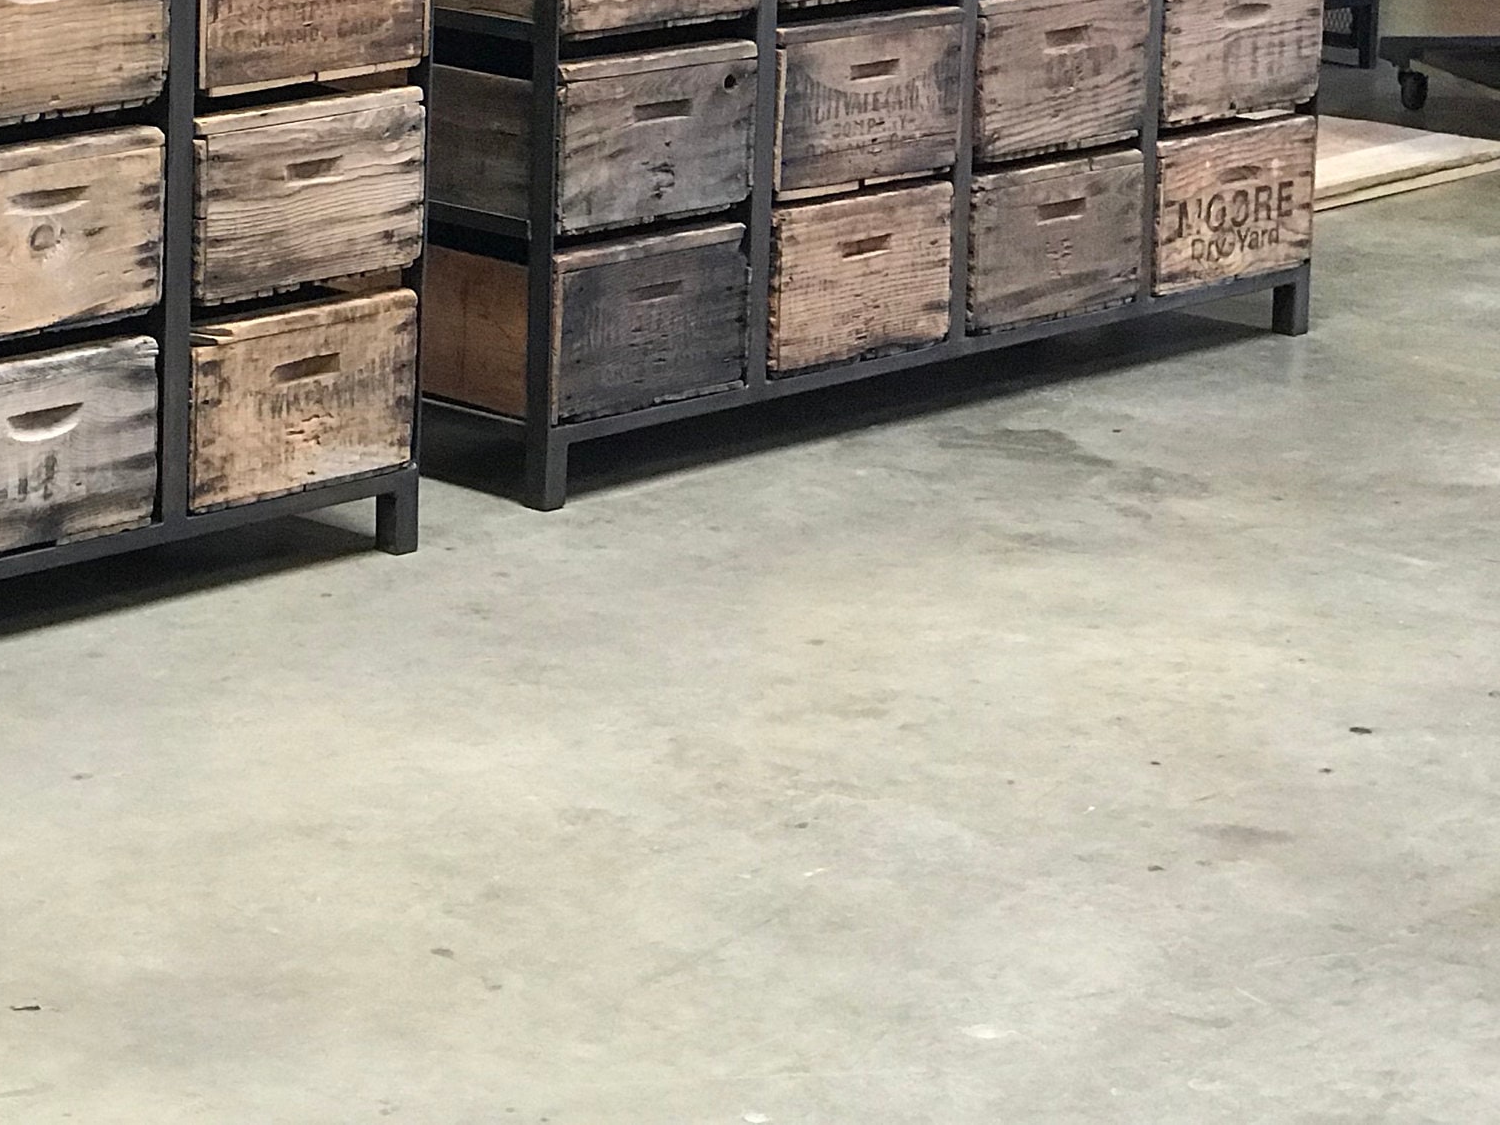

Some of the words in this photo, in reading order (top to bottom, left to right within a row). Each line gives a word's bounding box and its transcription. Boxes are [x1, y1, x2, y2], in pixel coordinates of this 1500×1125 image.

[790, 70, 883, 125] RUITVALE
[1176, 179, 1295, 239] MOORE
[1237, 225, 1281, 253] Yard
